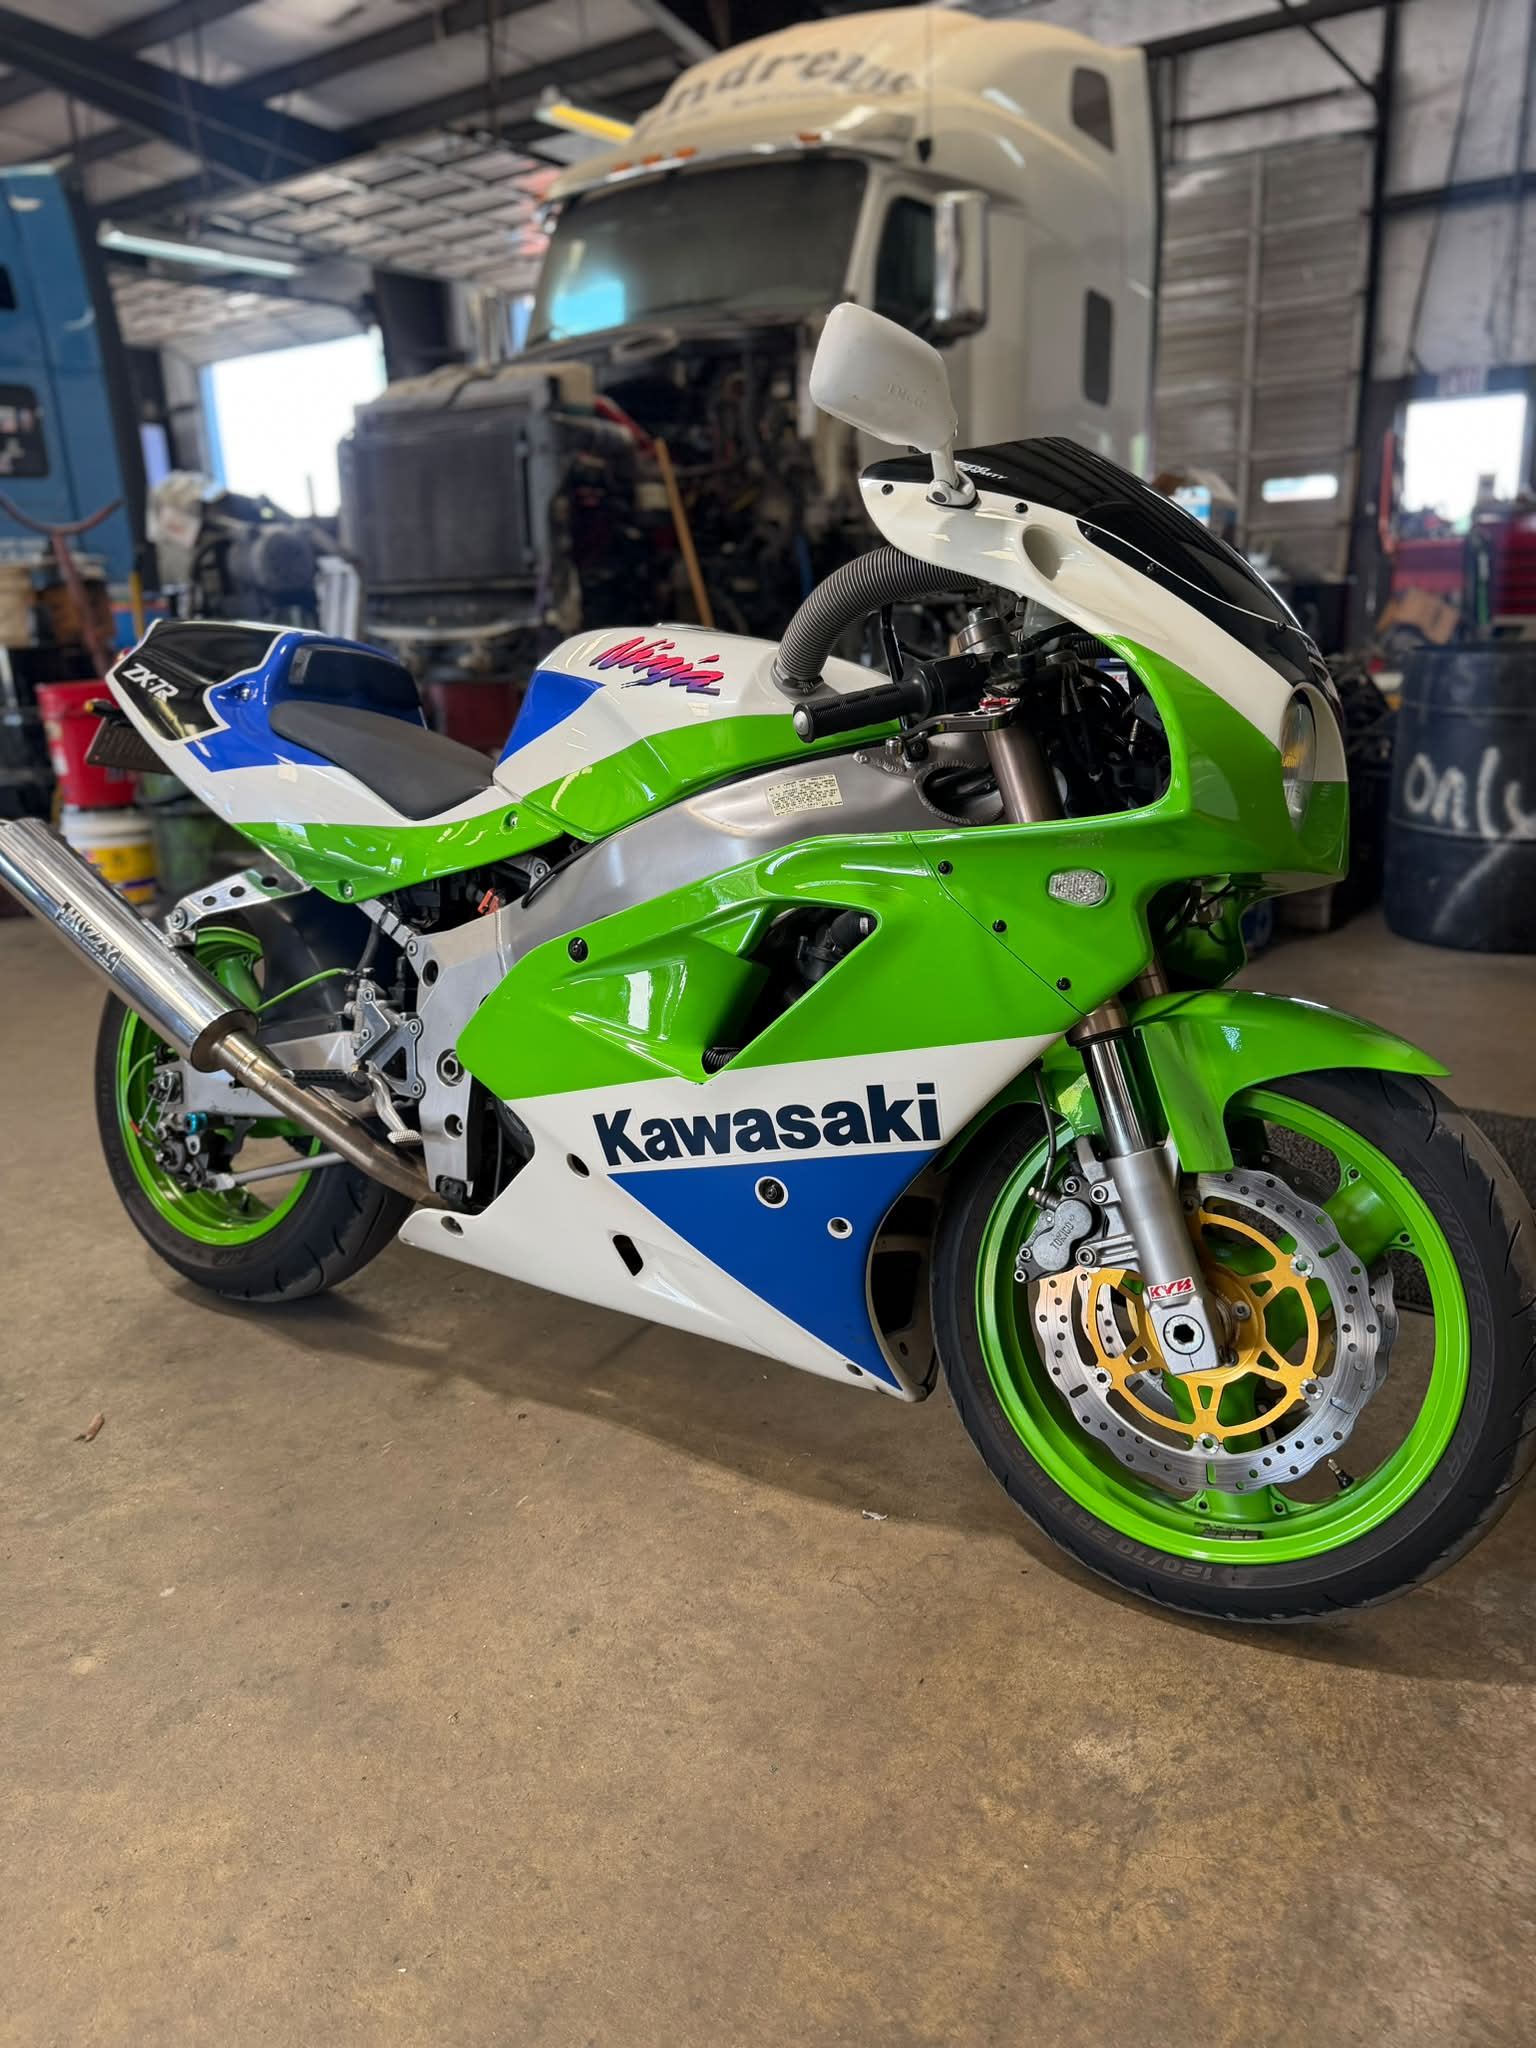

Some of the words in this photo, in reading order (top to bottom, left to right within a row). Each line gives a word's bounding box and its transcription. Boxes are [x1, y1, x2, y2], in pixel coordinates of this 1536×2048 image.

[589, 636, 725, 696] Ninja
[593, 1083, 941, 1167] Kawasaki
[1050, 1221, 1074, 1250] TOKICO
[1151, 1278, 1192, 1298] KYB
[1114, 1537, 1214, 1581] 120/70
